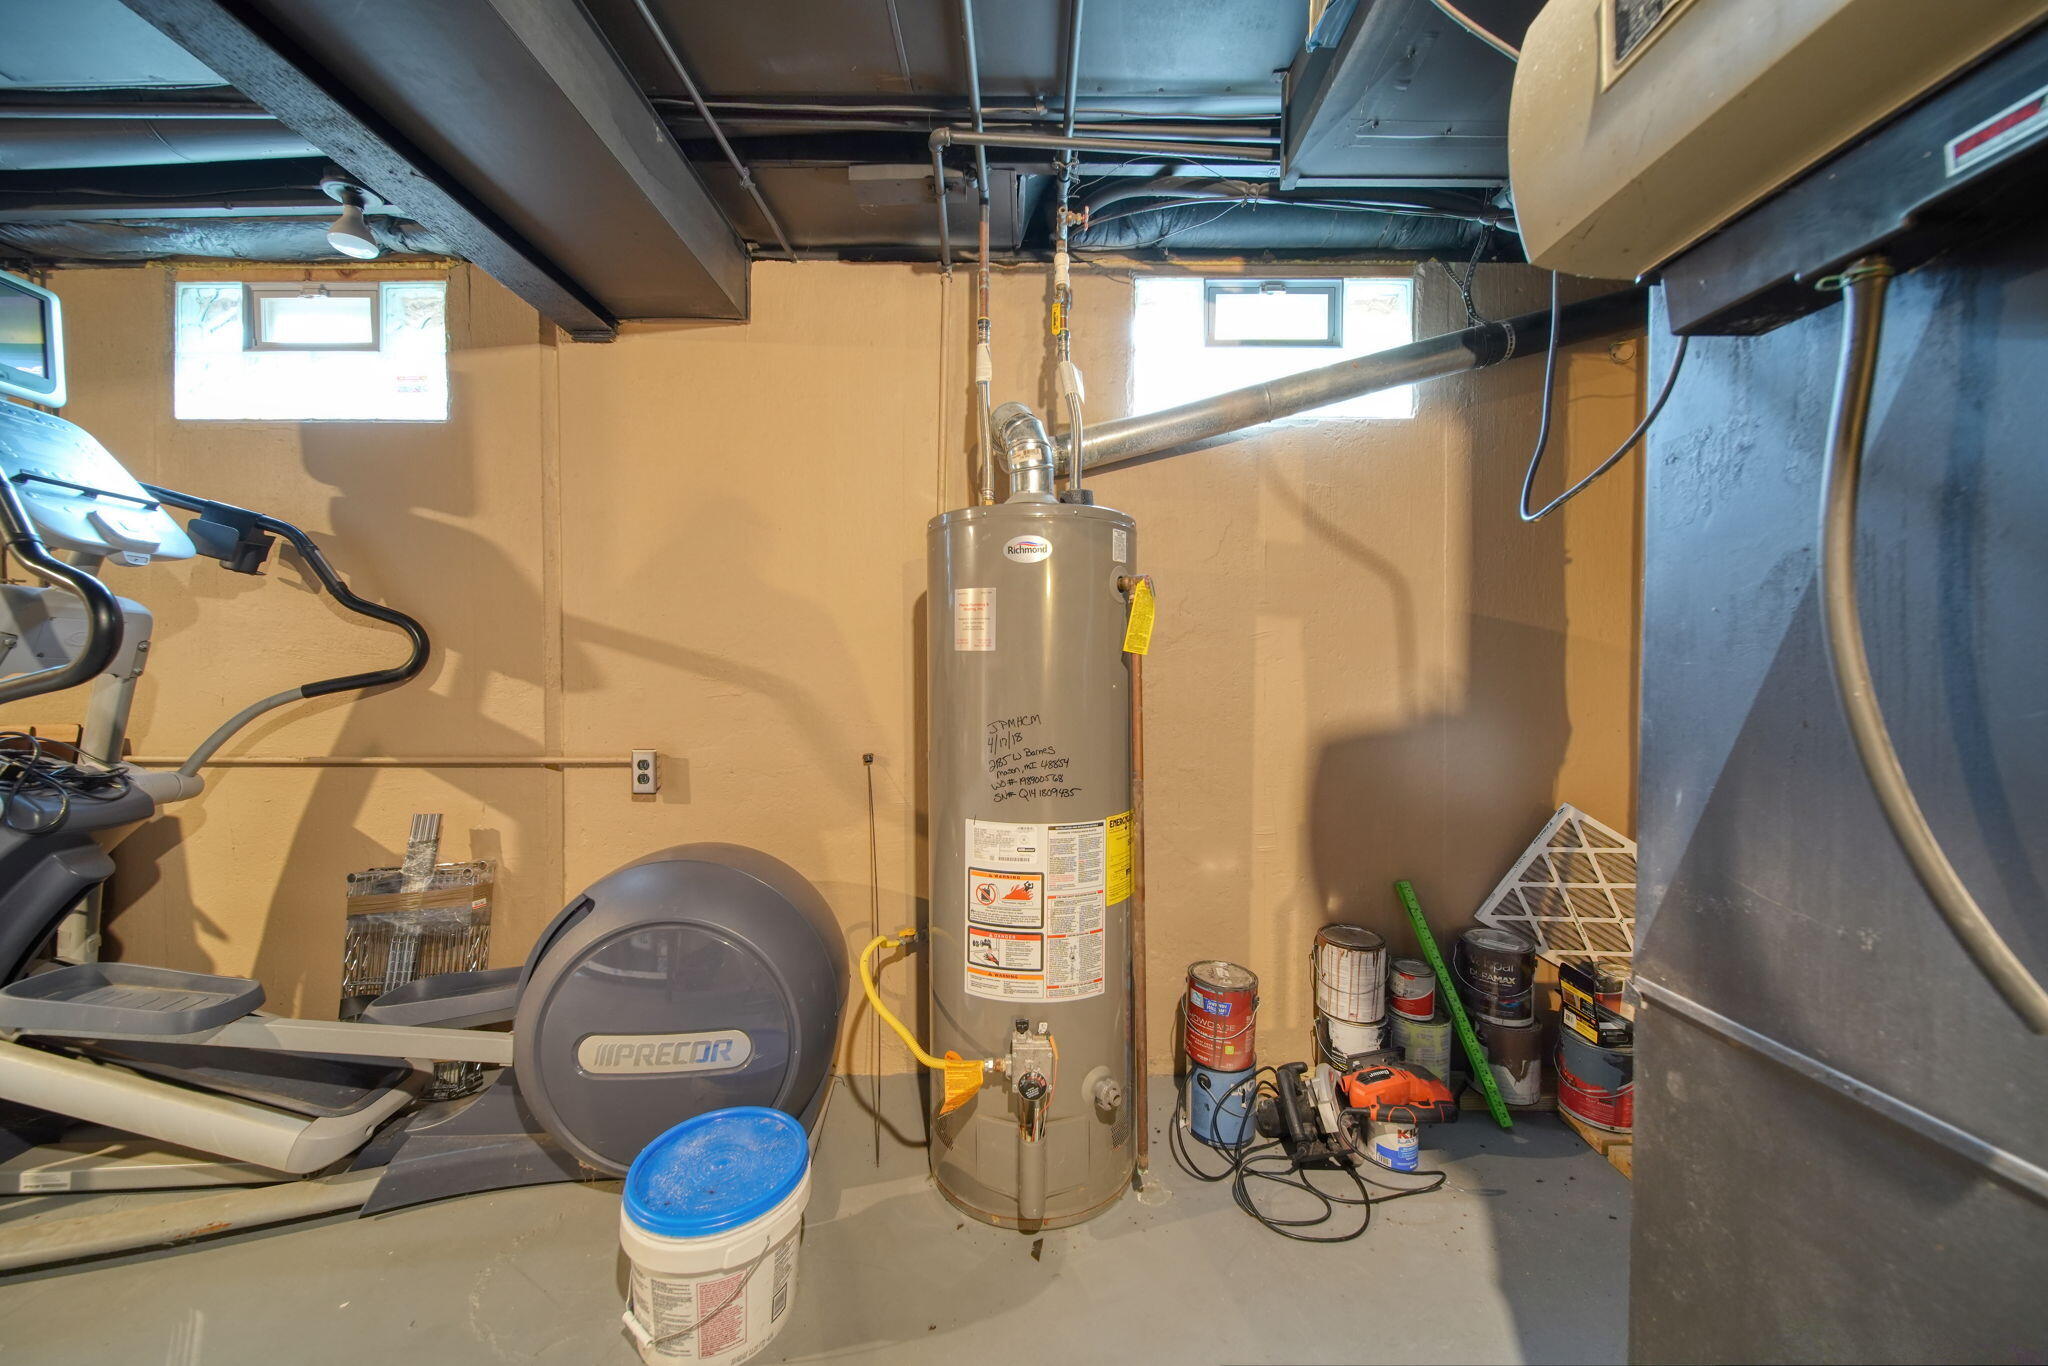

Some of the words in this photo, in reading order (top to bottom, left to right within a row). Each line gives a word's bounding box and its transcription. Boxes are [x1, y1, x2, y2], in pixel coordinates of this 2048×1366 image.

[1007, 544, 1048, 555] Richmond
[987, 714, 1042, 734] JPMHCM
[987, 731, 1023, 755] 4/17/18
[1012, 753, 1022, 761] W
[612, 1039, 733, 1067] PRECOR
